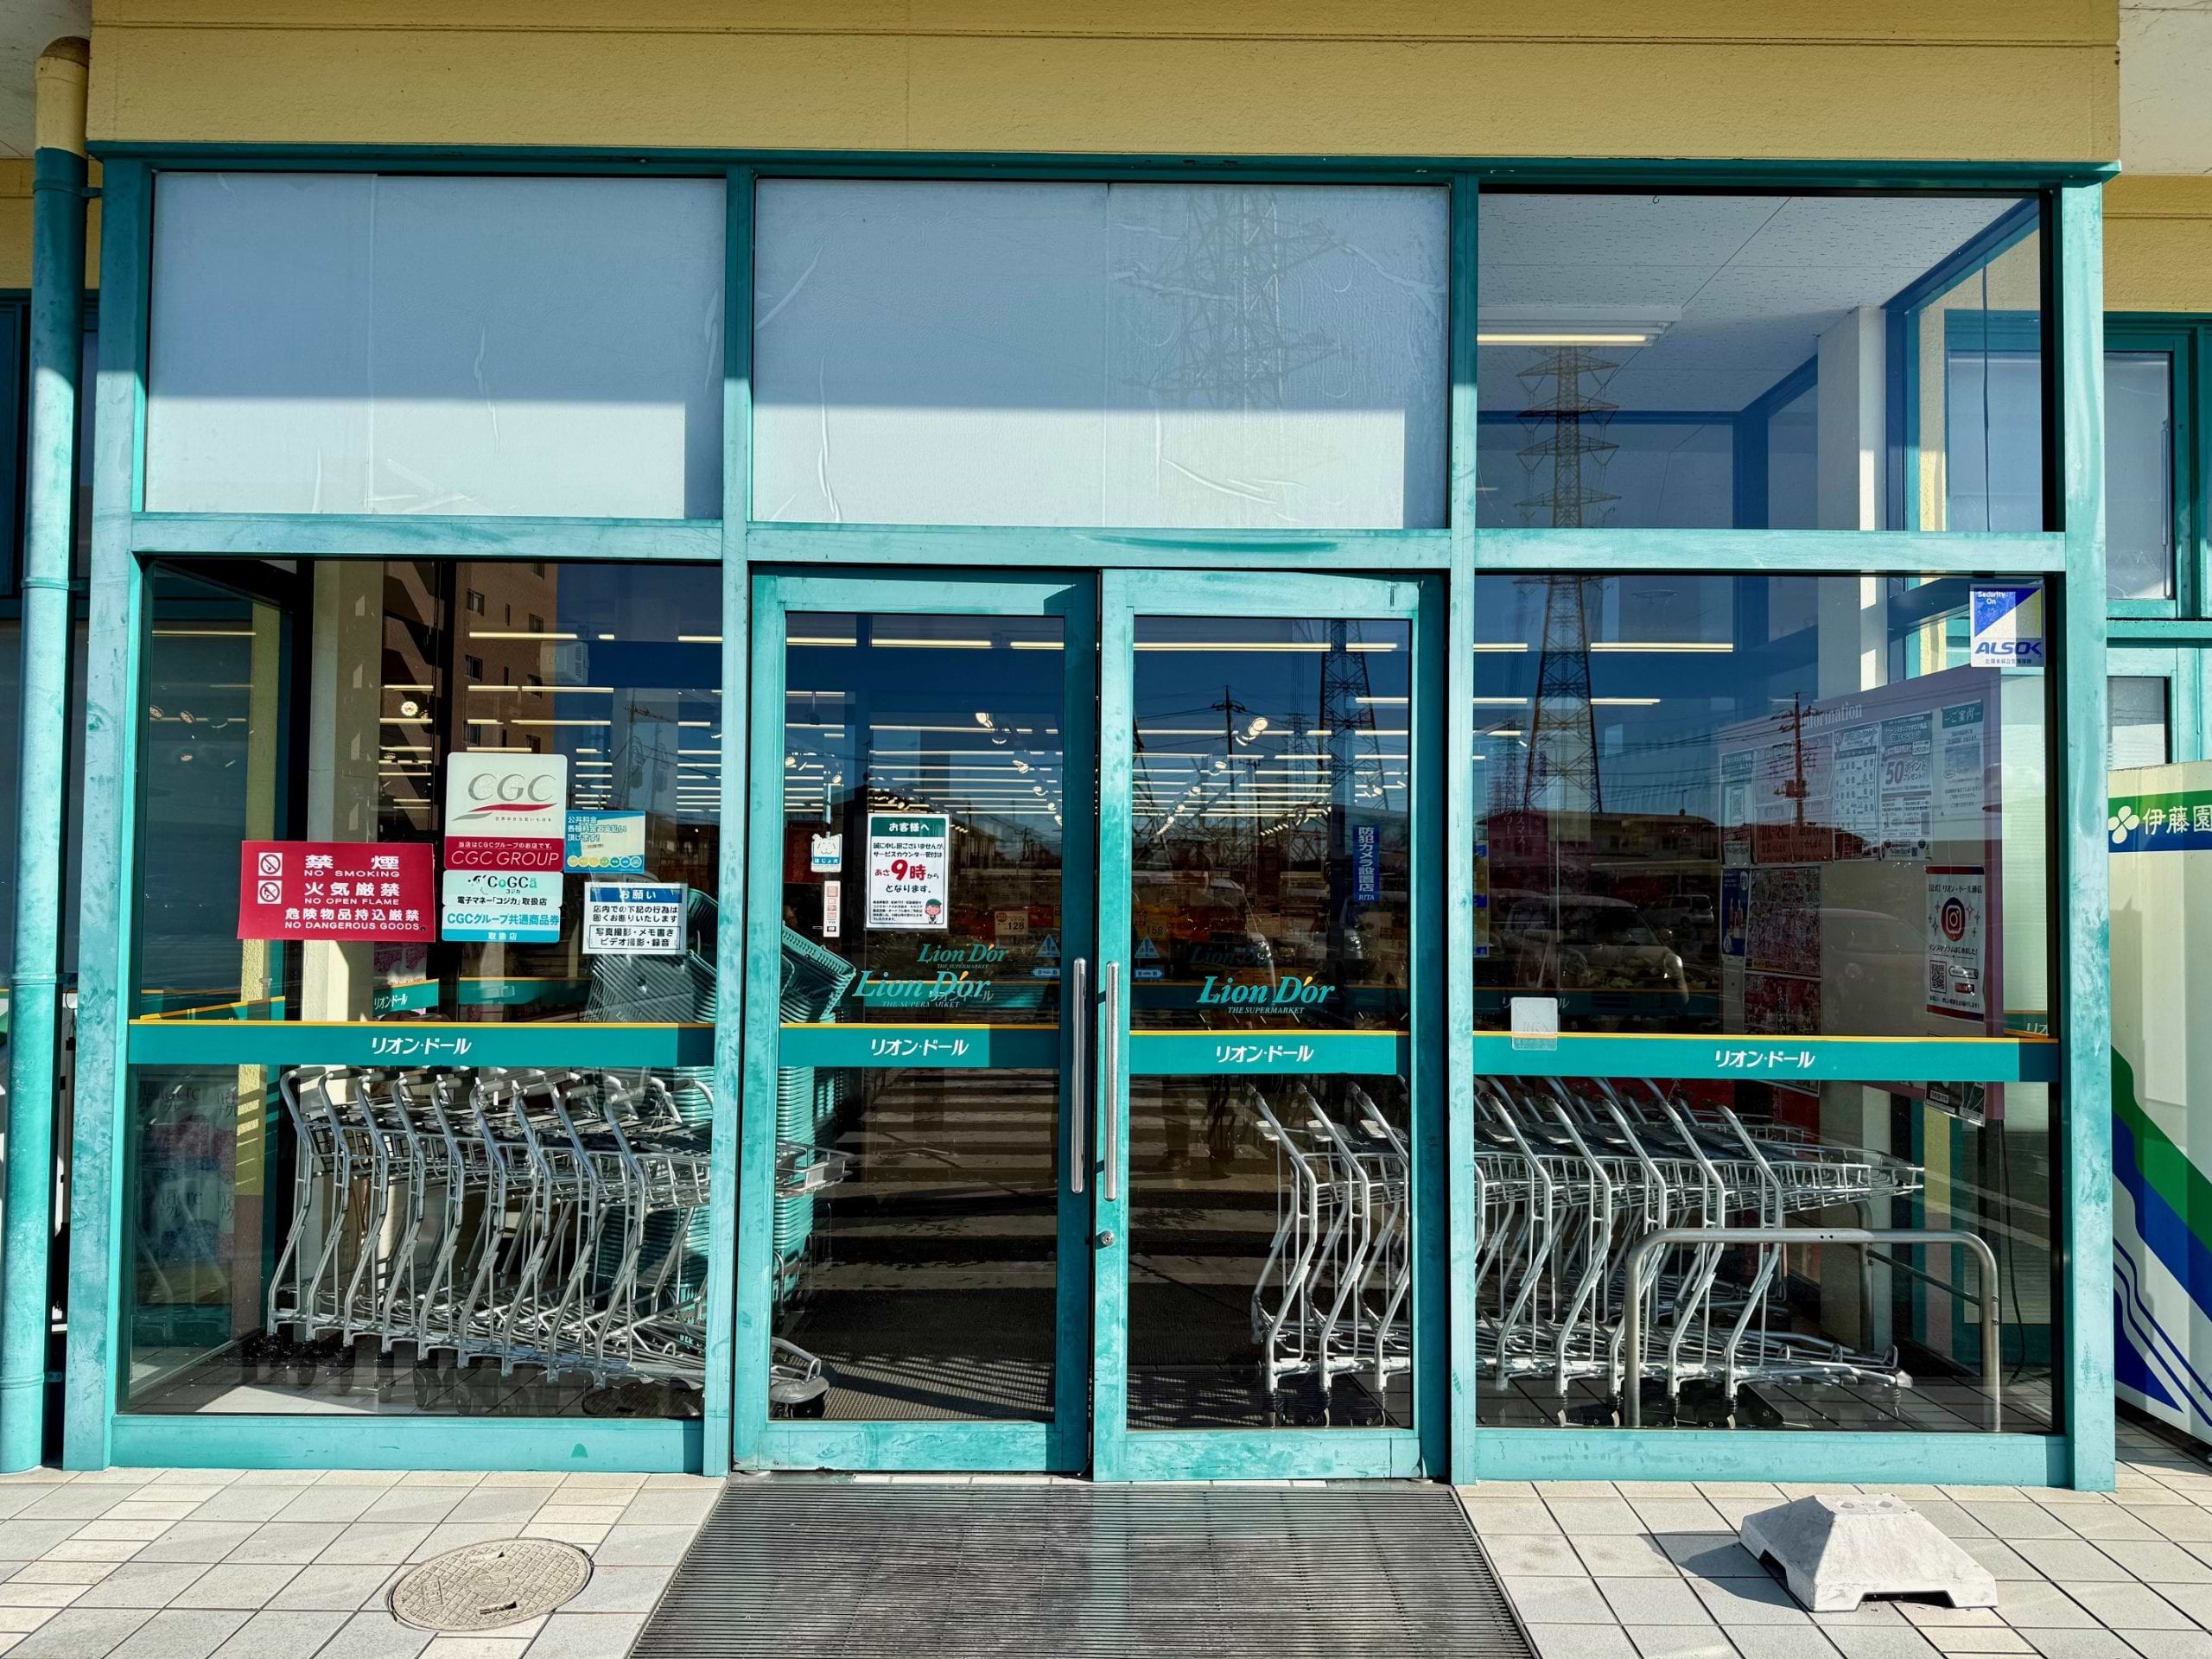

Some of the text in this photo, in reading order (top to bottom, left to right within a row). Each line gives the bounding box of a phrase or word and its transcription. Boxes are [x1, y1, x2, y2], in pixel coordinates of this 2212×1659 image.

[1974, 642, 2042, 656] ALSOK
[1885, 760, 1904, 785] 50
[467, 772, 556, 802] CGC
[568, 816, 597, 824] 公共料金
[889, 823, 930, 833] お客様へ
[2143, 804, 2212, 836] 伊藤園
[451, 850, 493, 865] CGC
[496, 851, 559, 866] GROUP
[1358, 827, 1375, 892] 防犯カメラ設置店
[304, 881, 400, 897] 火気厳禁
[619, 889, 657, 899] お願い
[886, 885, 931, 893] となります。
[457, 896, 547, 906] 電子マネー「コジカ」取扱店
[285, 907, 419, 921] 危険物品持込厳禁
[447, 912, 559, 925] CGCグループ共通商品券
[593, 914, 677, 923] 固くお断りいたします
[595, 927, 674, 937] 写真撮影・メモ書き
[1007, 921, 1025, 931] 128
[601, 938, 670, 947] ビデオ撮影・録音
[917, 944, 966, 963] Lion
[852, 970, 925, 997] Lion
[1197, 976, 1268, 1004] Lion
[372, 1037, 472, 1055] リオン・ドール
[870, 1039, 969, 1057] リオン・ドール
[1216, 1046, 1314, 1063] リオン・ドール
[1715, 1050, 1816, 1068] リオン・ドール
